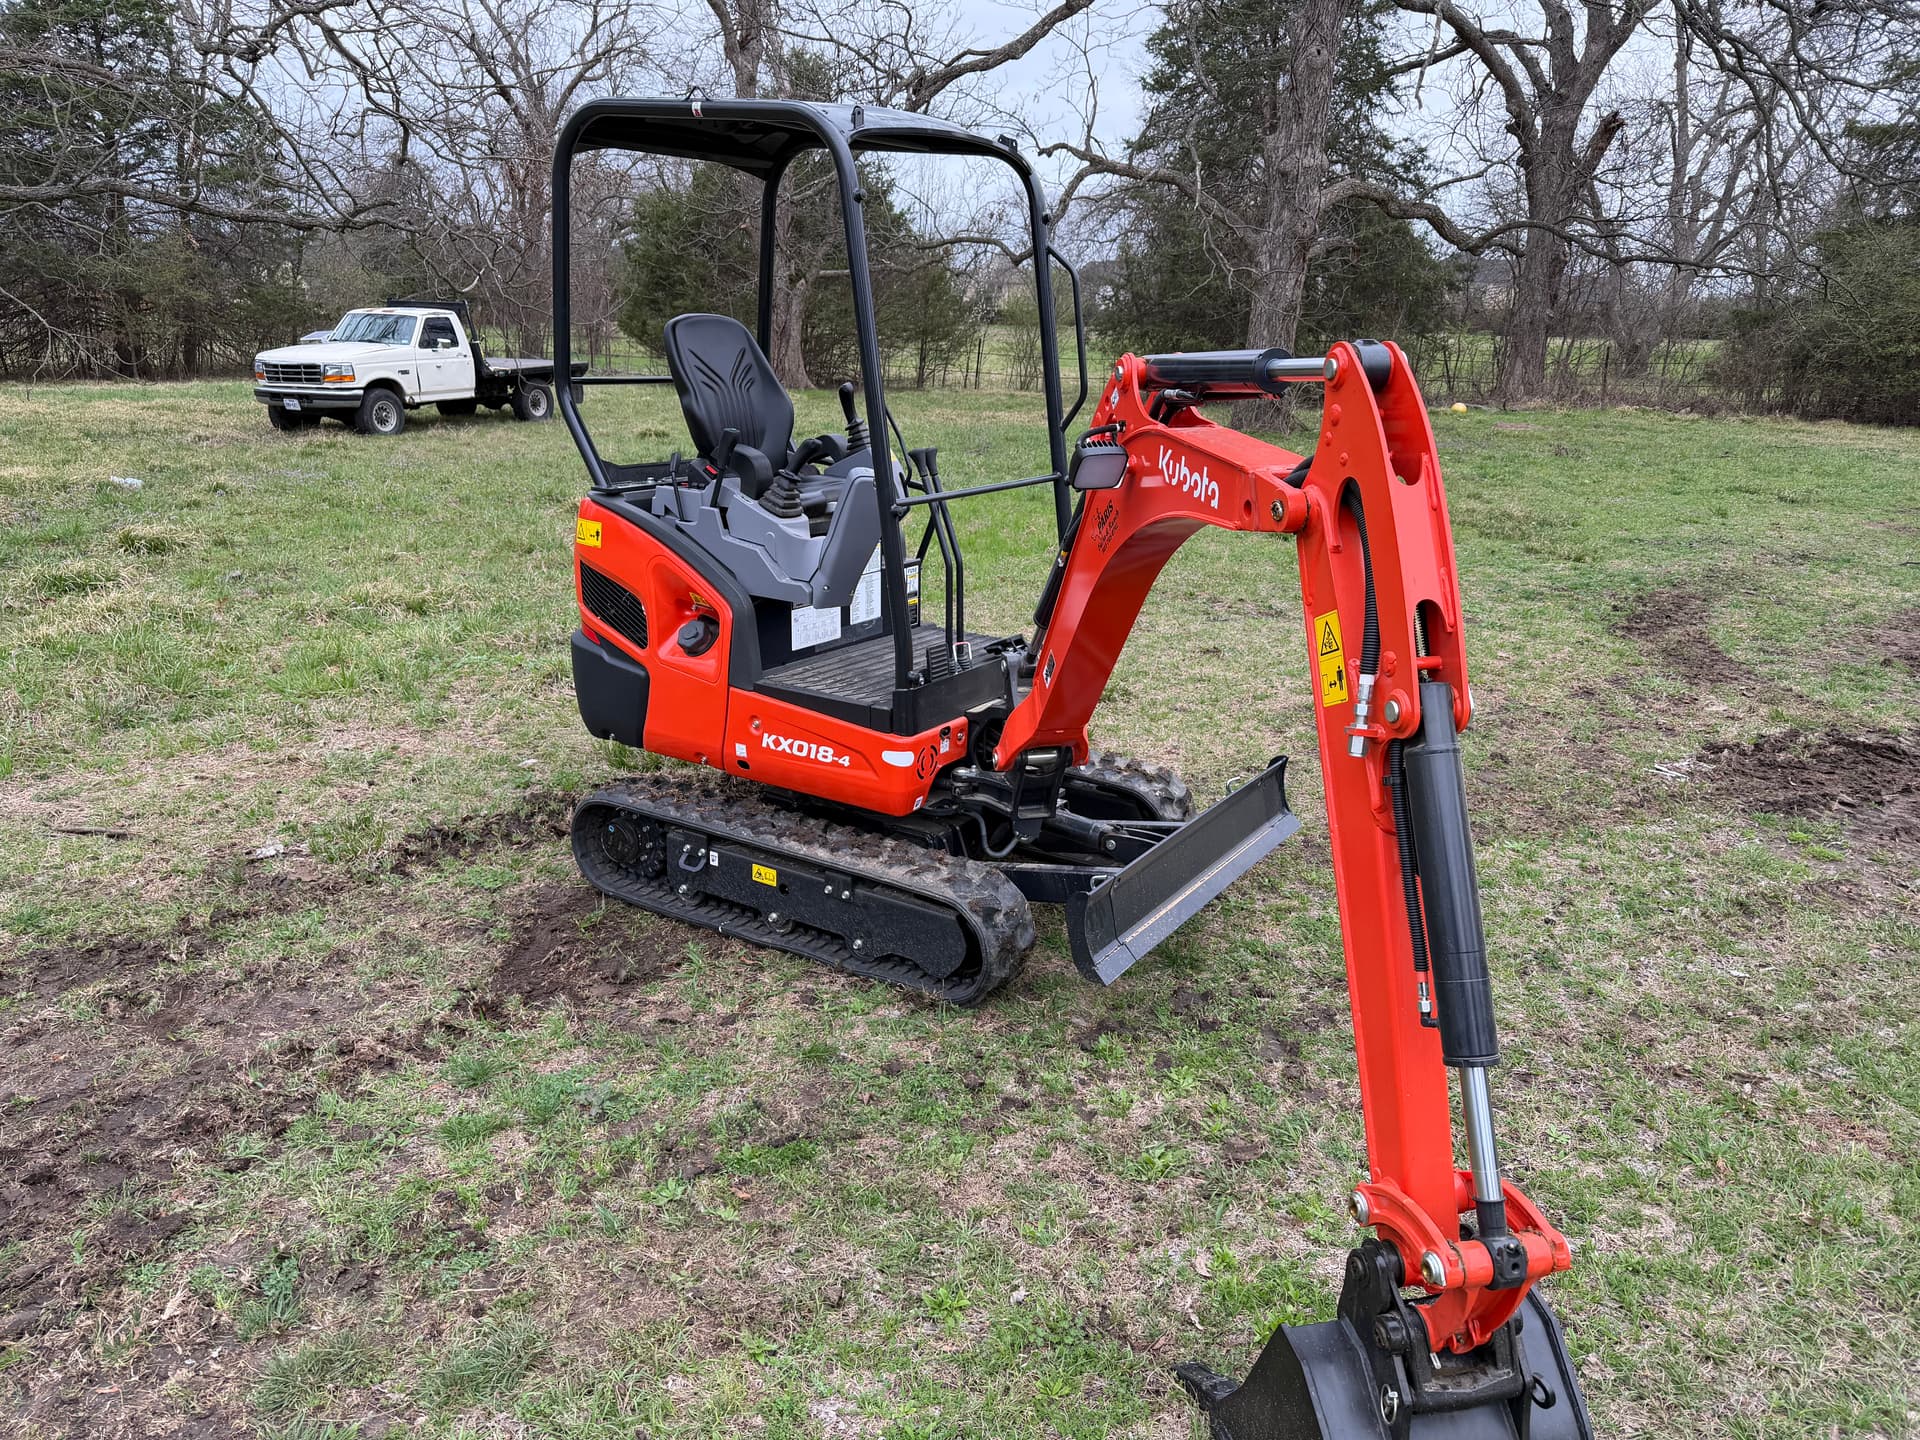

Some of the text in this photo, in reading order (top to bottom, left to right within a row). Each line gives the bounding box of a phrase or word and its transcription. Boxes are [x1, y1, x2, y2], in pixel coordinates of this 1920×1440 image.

[1158, 444, 1220, 510] Kubota
[1098, 499, 1113, 533] PARIS
[761, 732, 850, 768] KX018-4
